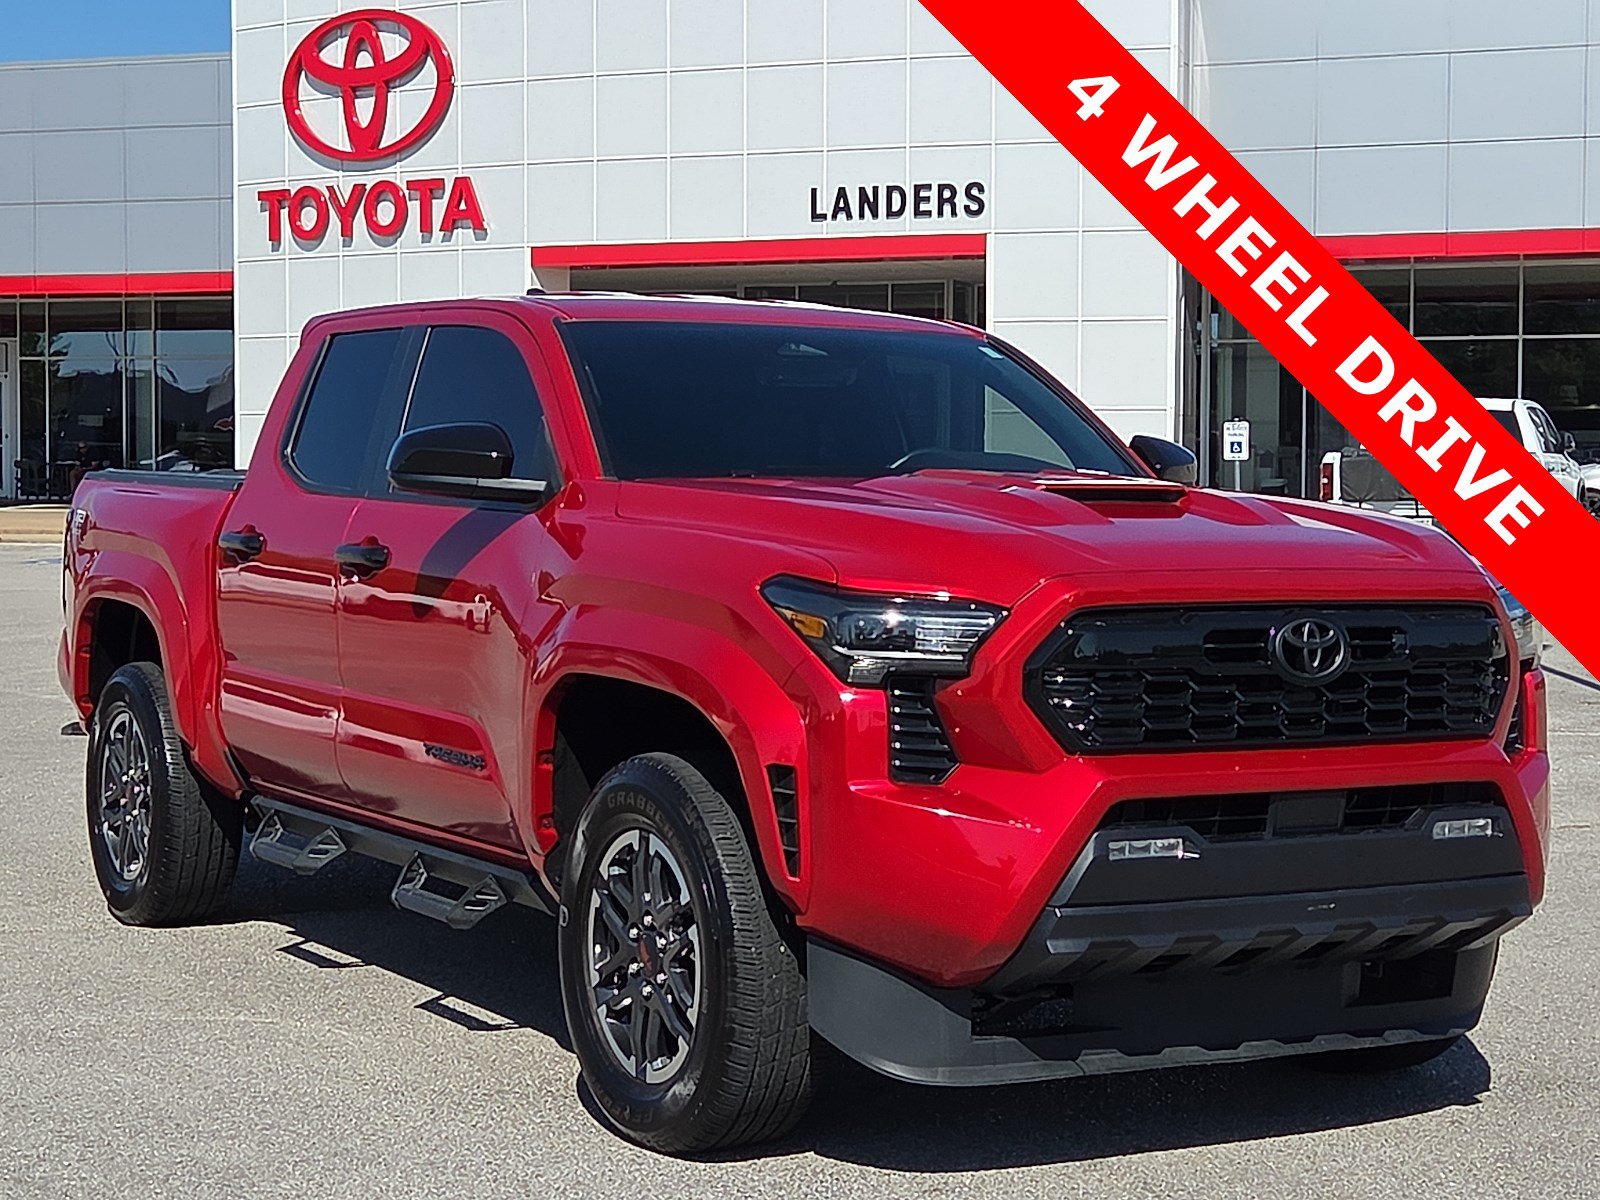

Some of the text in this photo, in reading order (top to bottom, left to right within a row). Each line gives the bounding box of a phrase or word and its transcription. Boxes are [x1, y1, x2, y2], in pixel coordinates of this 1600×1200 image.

[259, 177, 484, 242] TOYOTA
[811, 182, 985, 222] LANDERS
[607, 791, 674, 838] GRABBER
